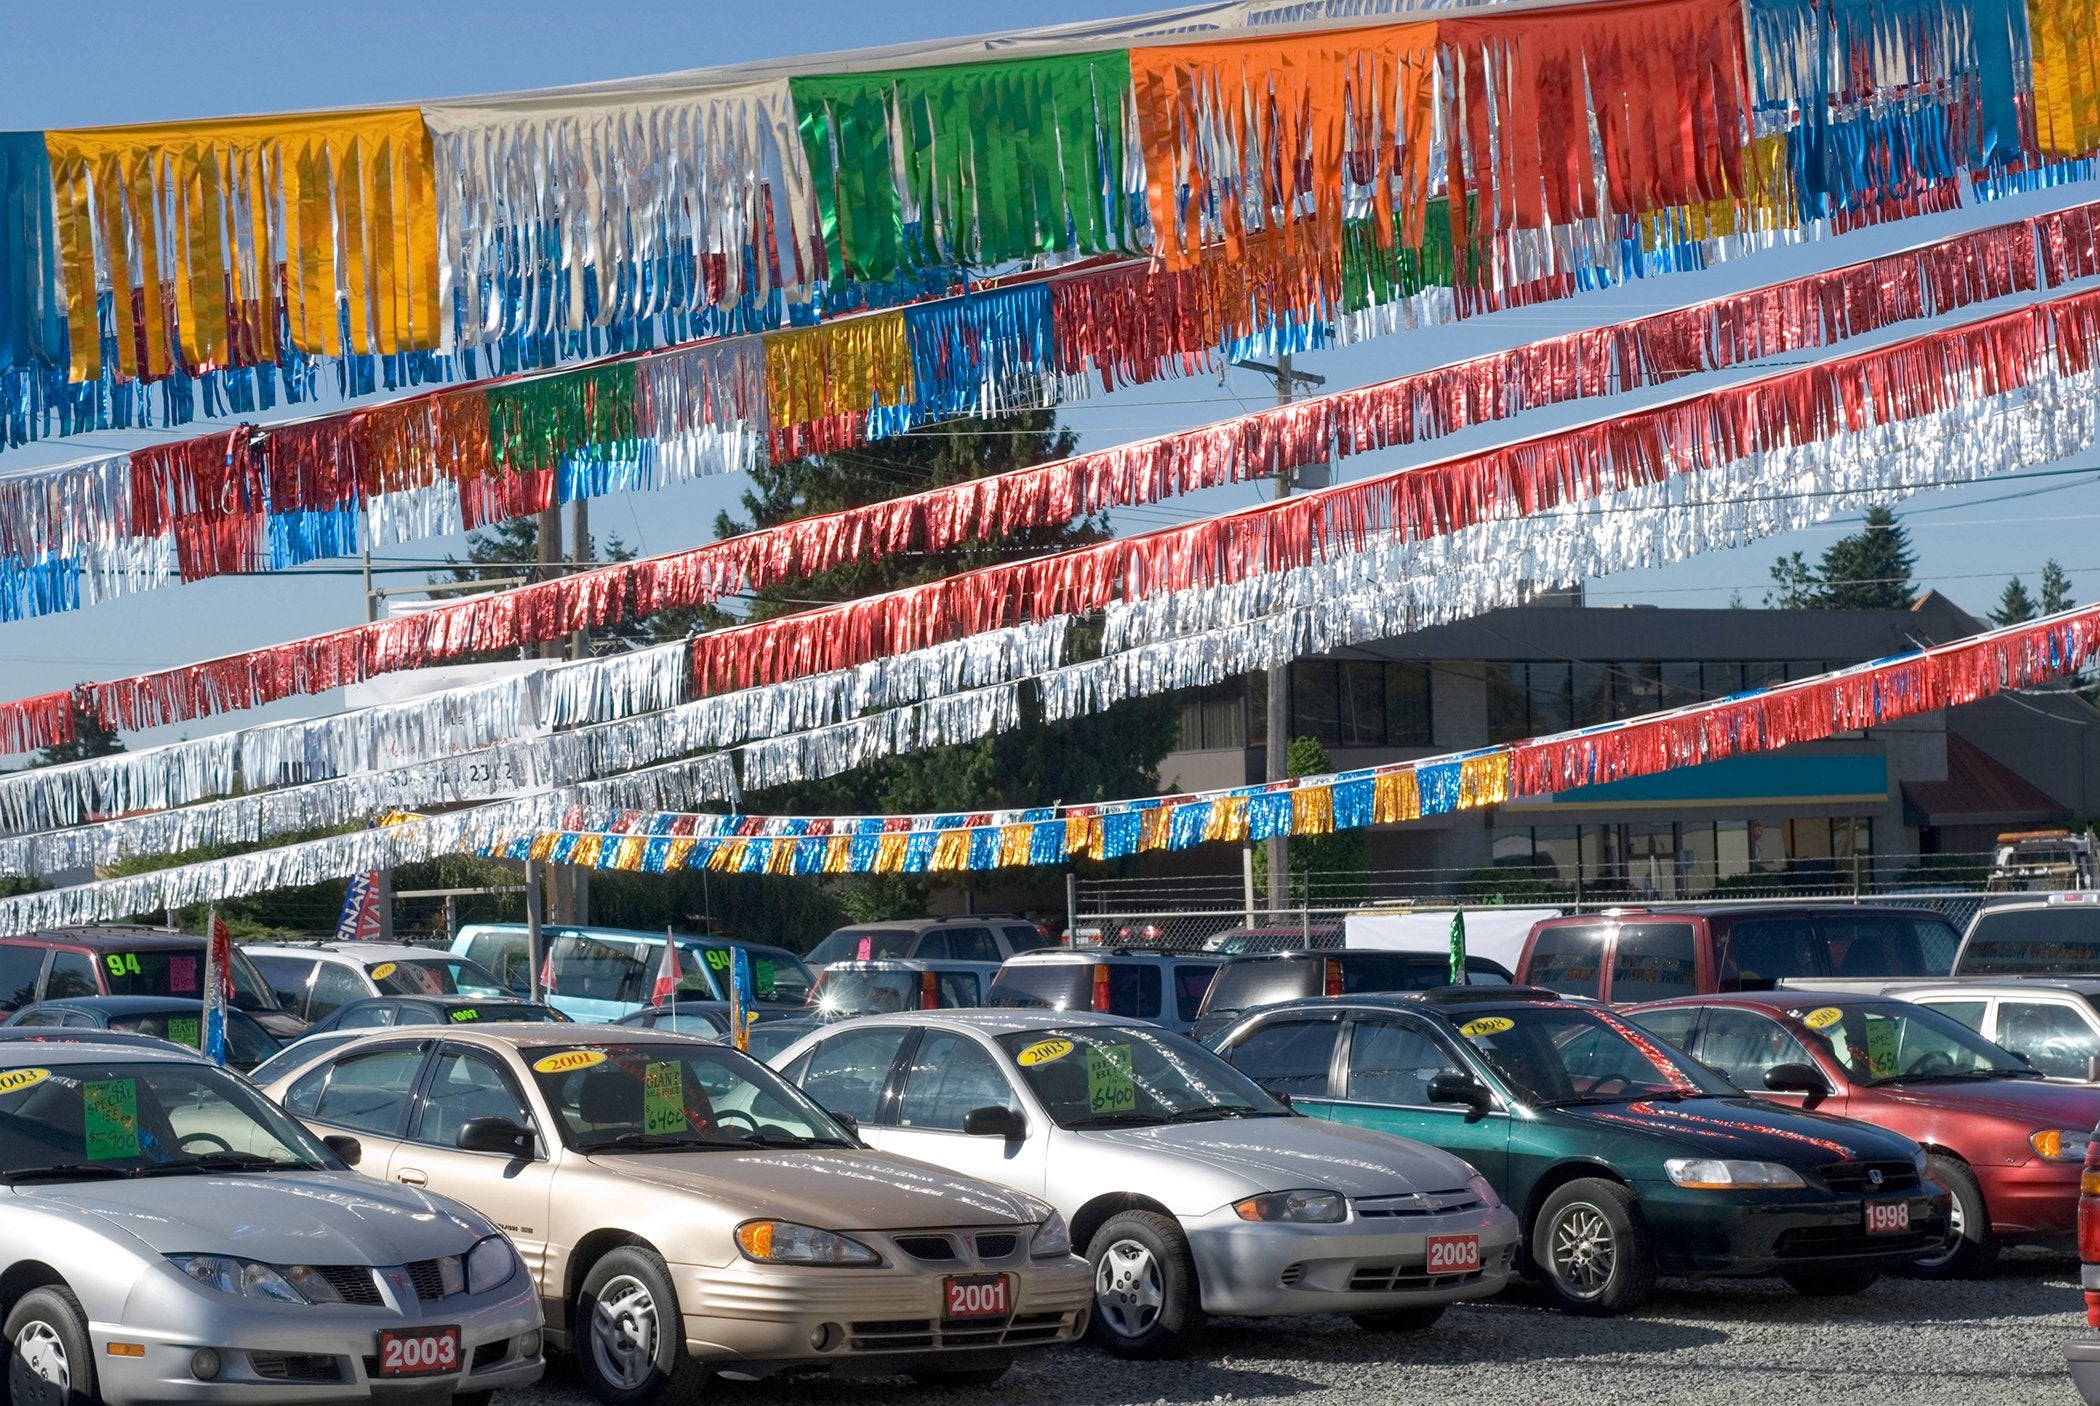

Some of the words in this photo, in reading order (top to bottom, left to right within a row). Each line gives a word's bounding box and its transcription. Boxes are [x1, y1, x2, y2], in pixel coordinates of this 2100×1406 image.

[106, 953, 141, 976] 94
[705, 950, 730, 970] 94
[452, 1009, 479, 1021] 1997
[1469, 1018, 1506, 1035] 1998
[547, 1052, 593, 1071] 2001
[1028, 1041, 1065, 1062] 2003
[0, 1070, 37, 1093] 003
[646, 1071, 680, 1089] GIANT
[1866, 1202, 1909, 1229] 1998
[1431, 1241, 1477, 1266] 2003
[951, 1283, 1004, 1312] 2001
[385, 1335, 455, 1367] 2003
